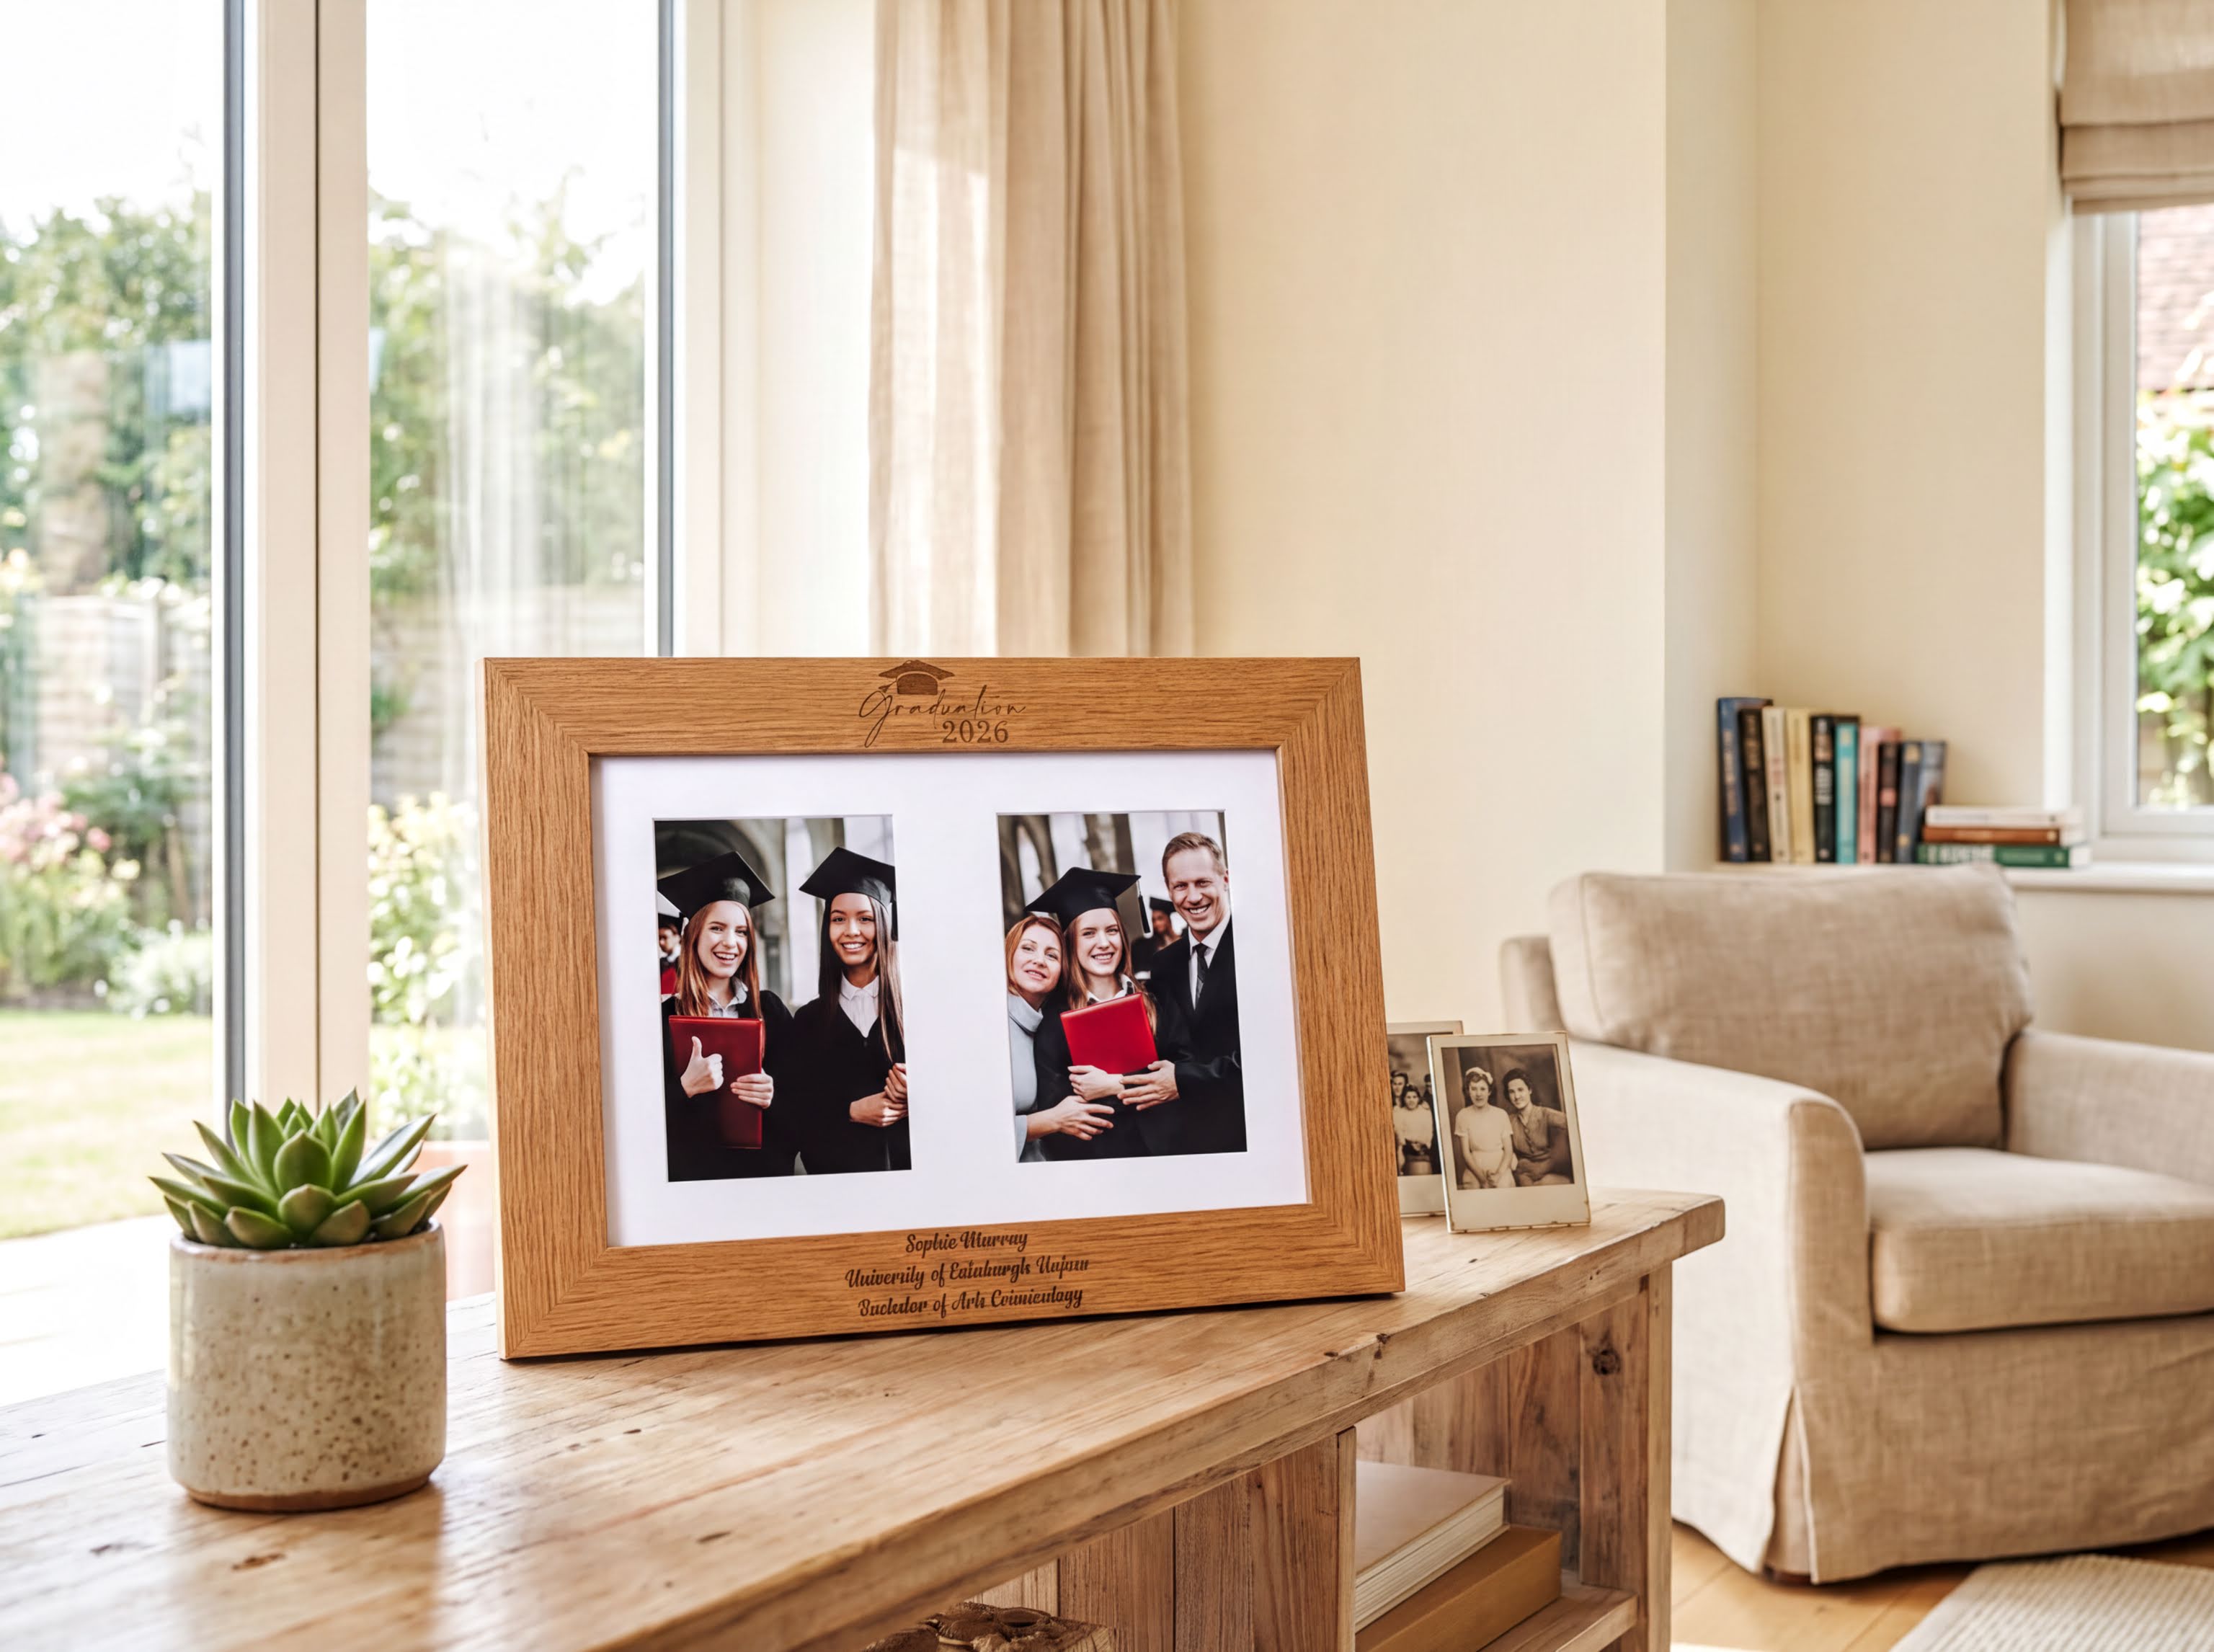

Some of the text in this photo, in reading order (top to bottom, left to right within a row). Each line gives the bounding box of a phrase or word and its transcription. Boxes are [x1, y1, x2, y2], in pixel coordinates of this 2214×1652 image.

[858, 684, 1026, 747] Graduation
[942, 719, 1009, 743] 2026
[905, 1233, 958, 1258] Sophie
[930, 1263, 946, 1288] of
[933, 1293, 947, 1319] of
[951, 1291, 985, 1312] Arts
